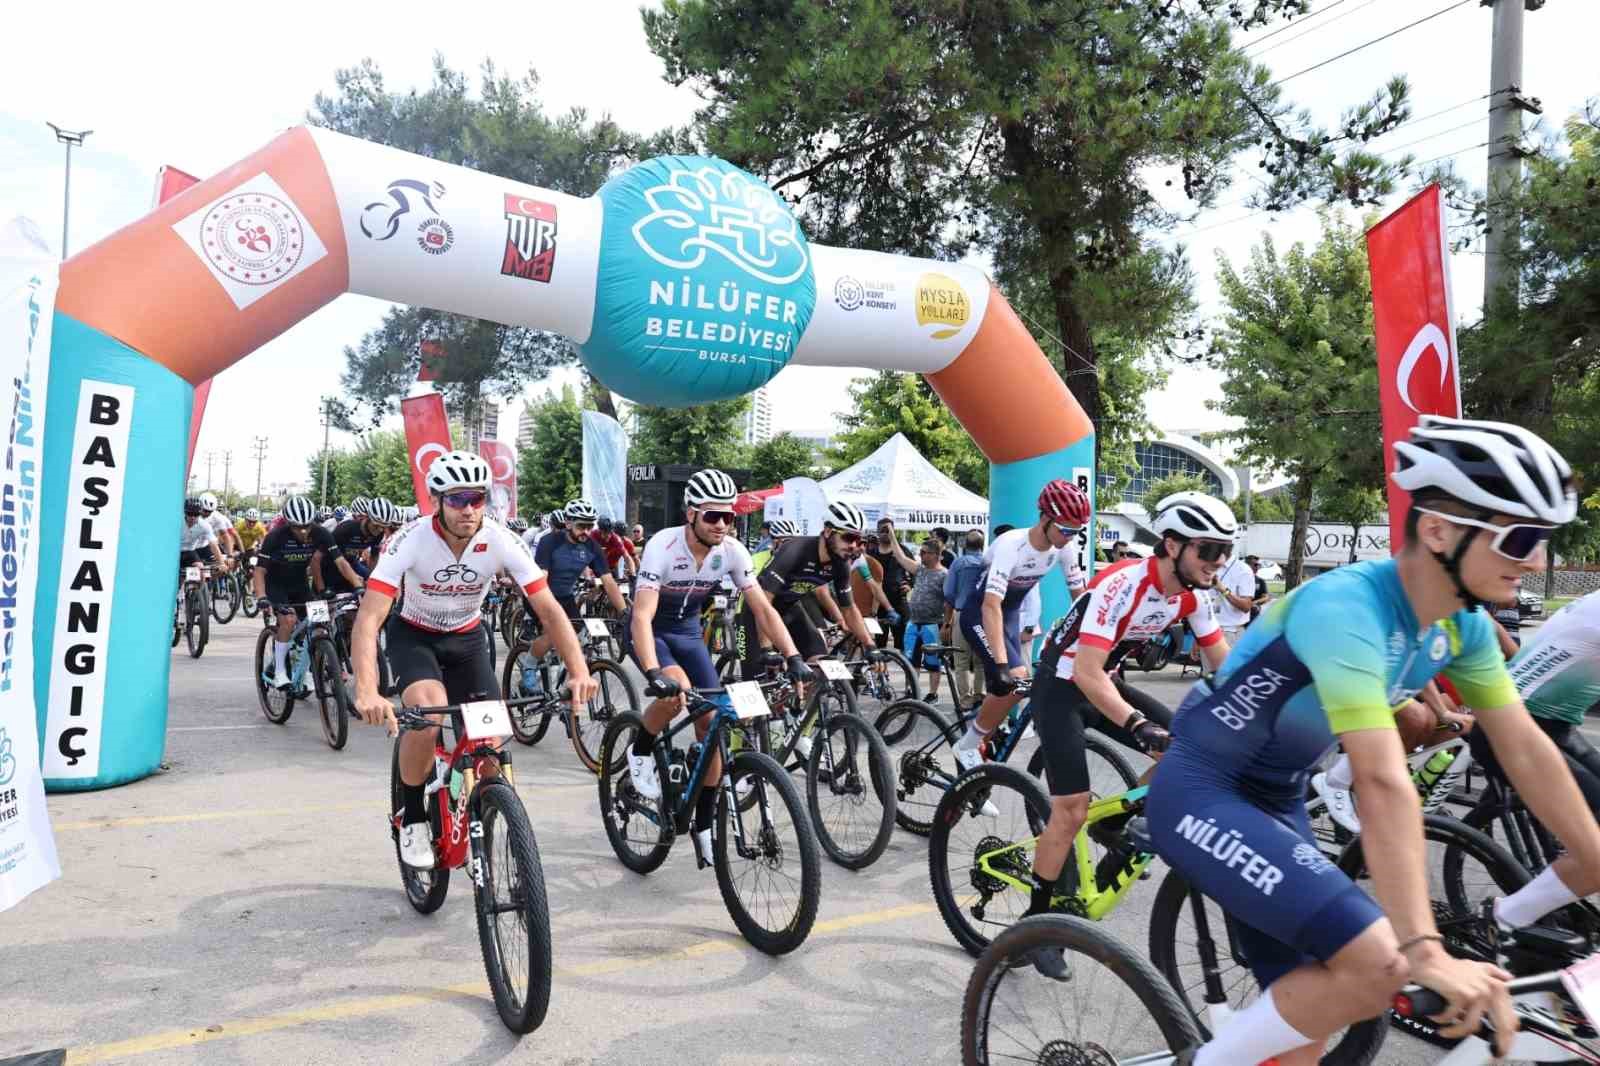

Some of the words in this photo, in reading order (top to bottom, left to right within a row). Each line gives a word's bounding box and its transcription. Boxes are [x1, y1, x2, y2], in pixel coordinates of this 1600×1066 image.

[649, 275, 798, 325] NİLÜFER
[920, 288, 965, 306] MYSIA
[645, 316, 793, 353] BELEDİYESİ
[698, 350, 747, 365] BURSA
[629, 463, 656, 481] VENLİK
[908, 510, 951, 524] NİLÜFER
[58, 393, 121, 766] BAŞLANGIÇ
[1211, 667, 1292, 731] BURSA
[481, 712, 494, 725] 6
[1175, 813, 1285, 896] NİLÜFER
